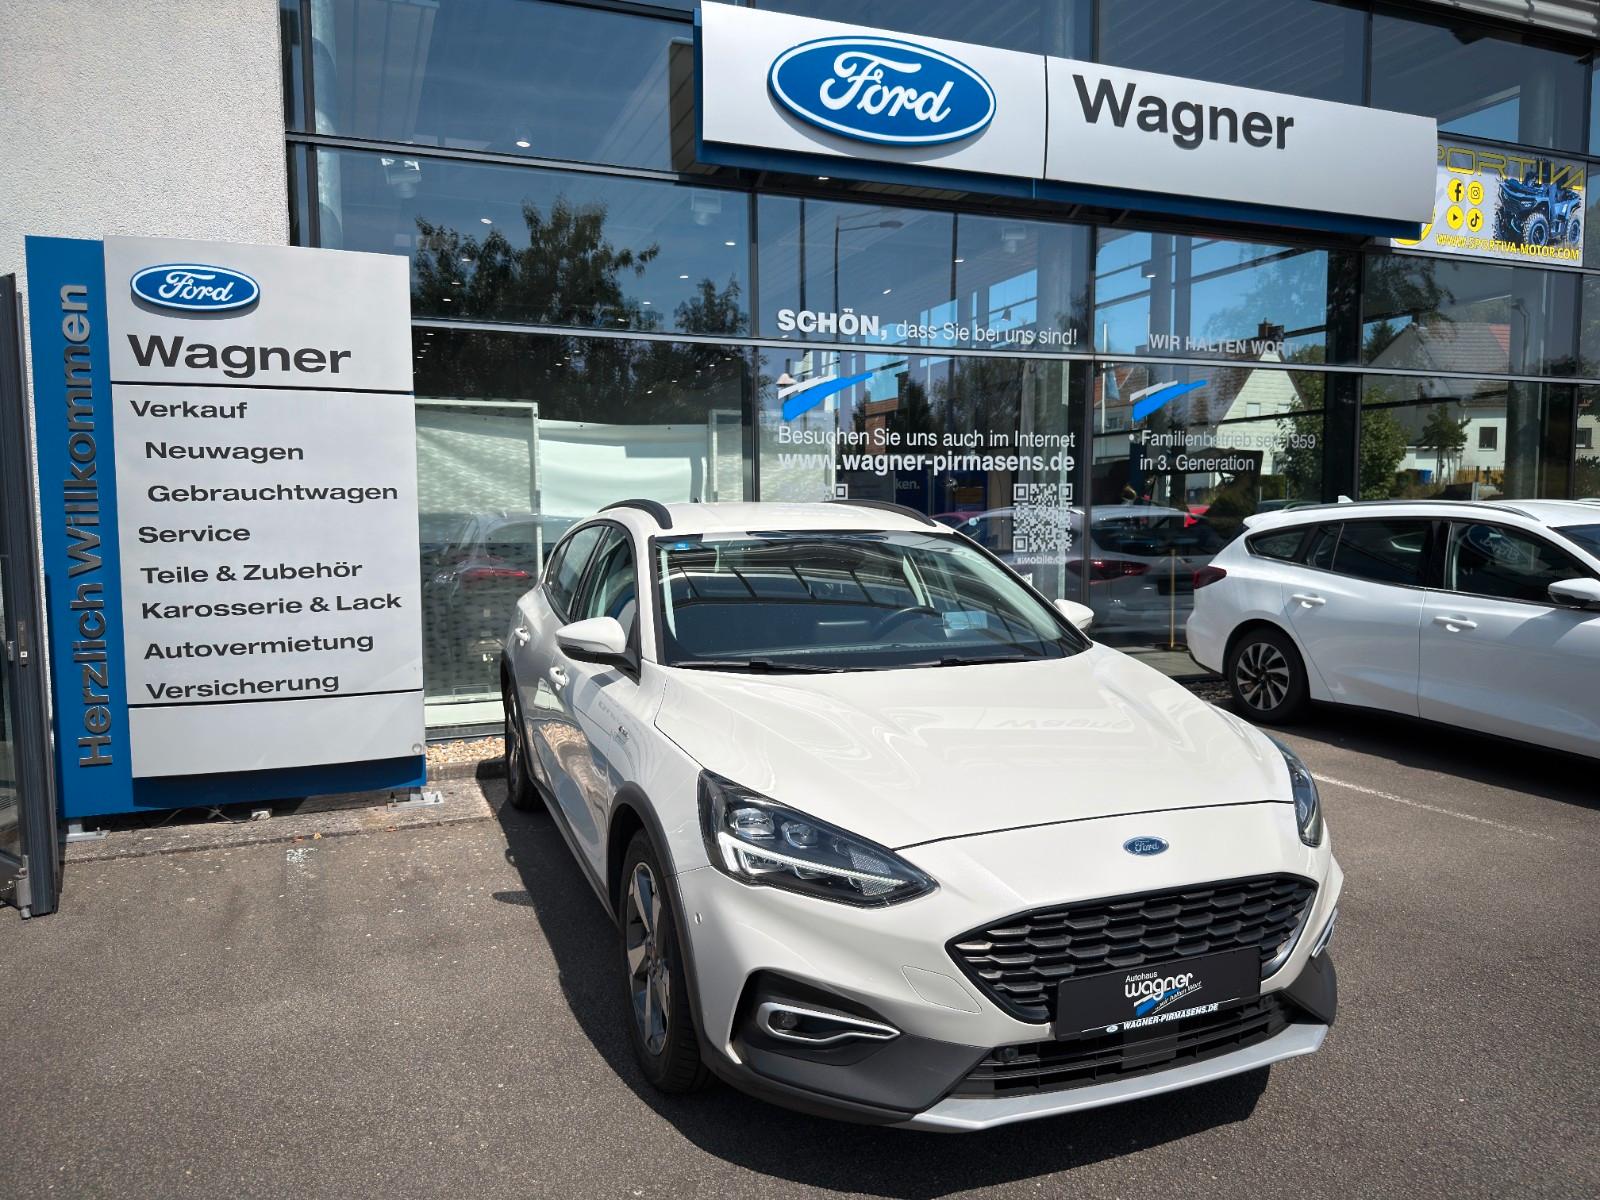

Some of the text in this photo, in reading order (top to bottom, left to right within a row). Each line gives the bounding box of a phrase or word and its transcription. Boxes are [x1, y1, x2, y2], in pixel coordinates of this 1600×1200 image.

[819, 51, 955, 124] Ford
[1072, 73, 1295, 151] Wagner
[158, 271, 235, 302] Ford
[776, 308, 1078, 346] SCHÖN, dass Sie bei uns sind!
[127, 334, 352, 379] Wagner
[1150, 333, 1180, 351] WIR
[1186, 336, 1247, 354] HALTEN
[130, 400, 248, 420] Verkauf
[778, 425, 1076, 449] Besuchen Sie uns auch im Internet
[1141, 429, 1251, 448] Familienbetrieb
[1285, 433, 1316, 450] 1959
[145, 441, 304, 463] Neuwagen
[778, 451, 1075, 476] www.wagner-pirmasens.de
[1139, 454, 1255, 472] in 3. Generation
[147, 483, 398, 504] Gebrauchtwagen
[60, 283, 113, 767] Herzlich Willkommen
[138, 525, 251, 544] Service
[140, 561, 363, 584] Teile & Zubehör
[141, 592, 402, 619] Karosserie & Lack
[144, 632, 374, 660] Autovermietung
[145, 673, 340, 700] Versicherung
[1124, 972, 1194, 1001] wagner
[1125, 971, 1158, 984] Autohaus
[1123, 1002, 1219, 1030] WAGNER-PIRMASENS.DE
